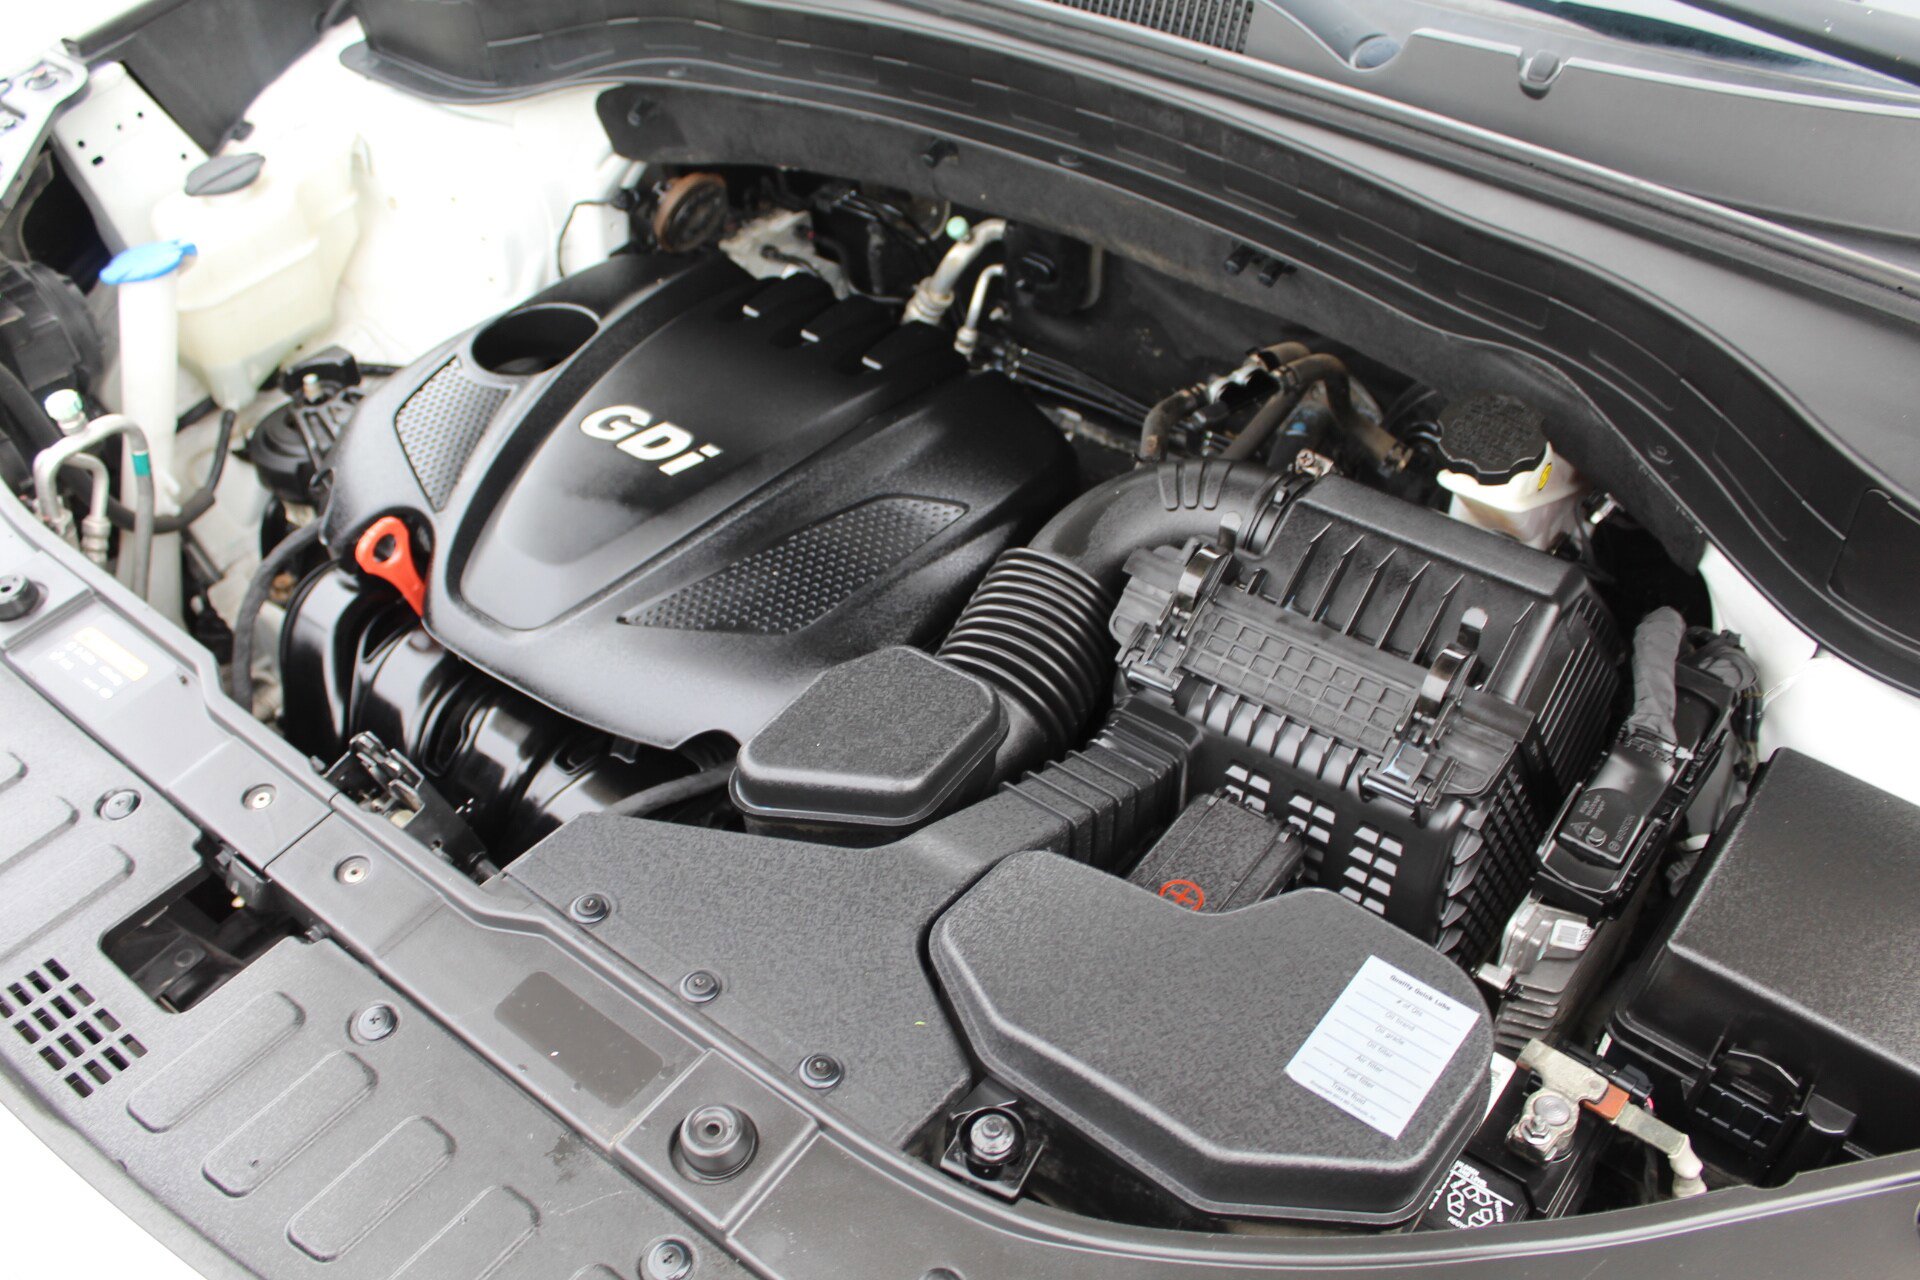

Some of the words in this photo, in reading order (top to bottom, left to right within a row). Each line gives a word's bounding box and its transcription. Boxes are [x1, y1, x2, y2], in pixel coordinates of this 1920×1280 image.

[580, 404, 724, 476] GDi
[1615, 813, 1635, 842] BOSCH
[1390, 974, 1413, 991] Quality
[1414, 988, 1433, 1001] Quick
[1434, 999, 1451, 1011] Lube
[1384, 1011, 1395, 1019] Oil
[1395, 1017, 1416, 1031] brand
[1374, 1025, 1385, 1034] Oil
[1385, 1031, 1405, 1046] grade
[1366, 1040, 1377, 1049] Oil
[1377, 1046, 1393, 1058] filter
[1355, 1054, 1366, 1063] Air
[1366, 1060, 1383, 1073] filter
[1343, 1067, 1358, 1079] Fuel
[1358, 1076, 1375, 1089] filter
[1350, 1092, 1367, 1105] fluid
